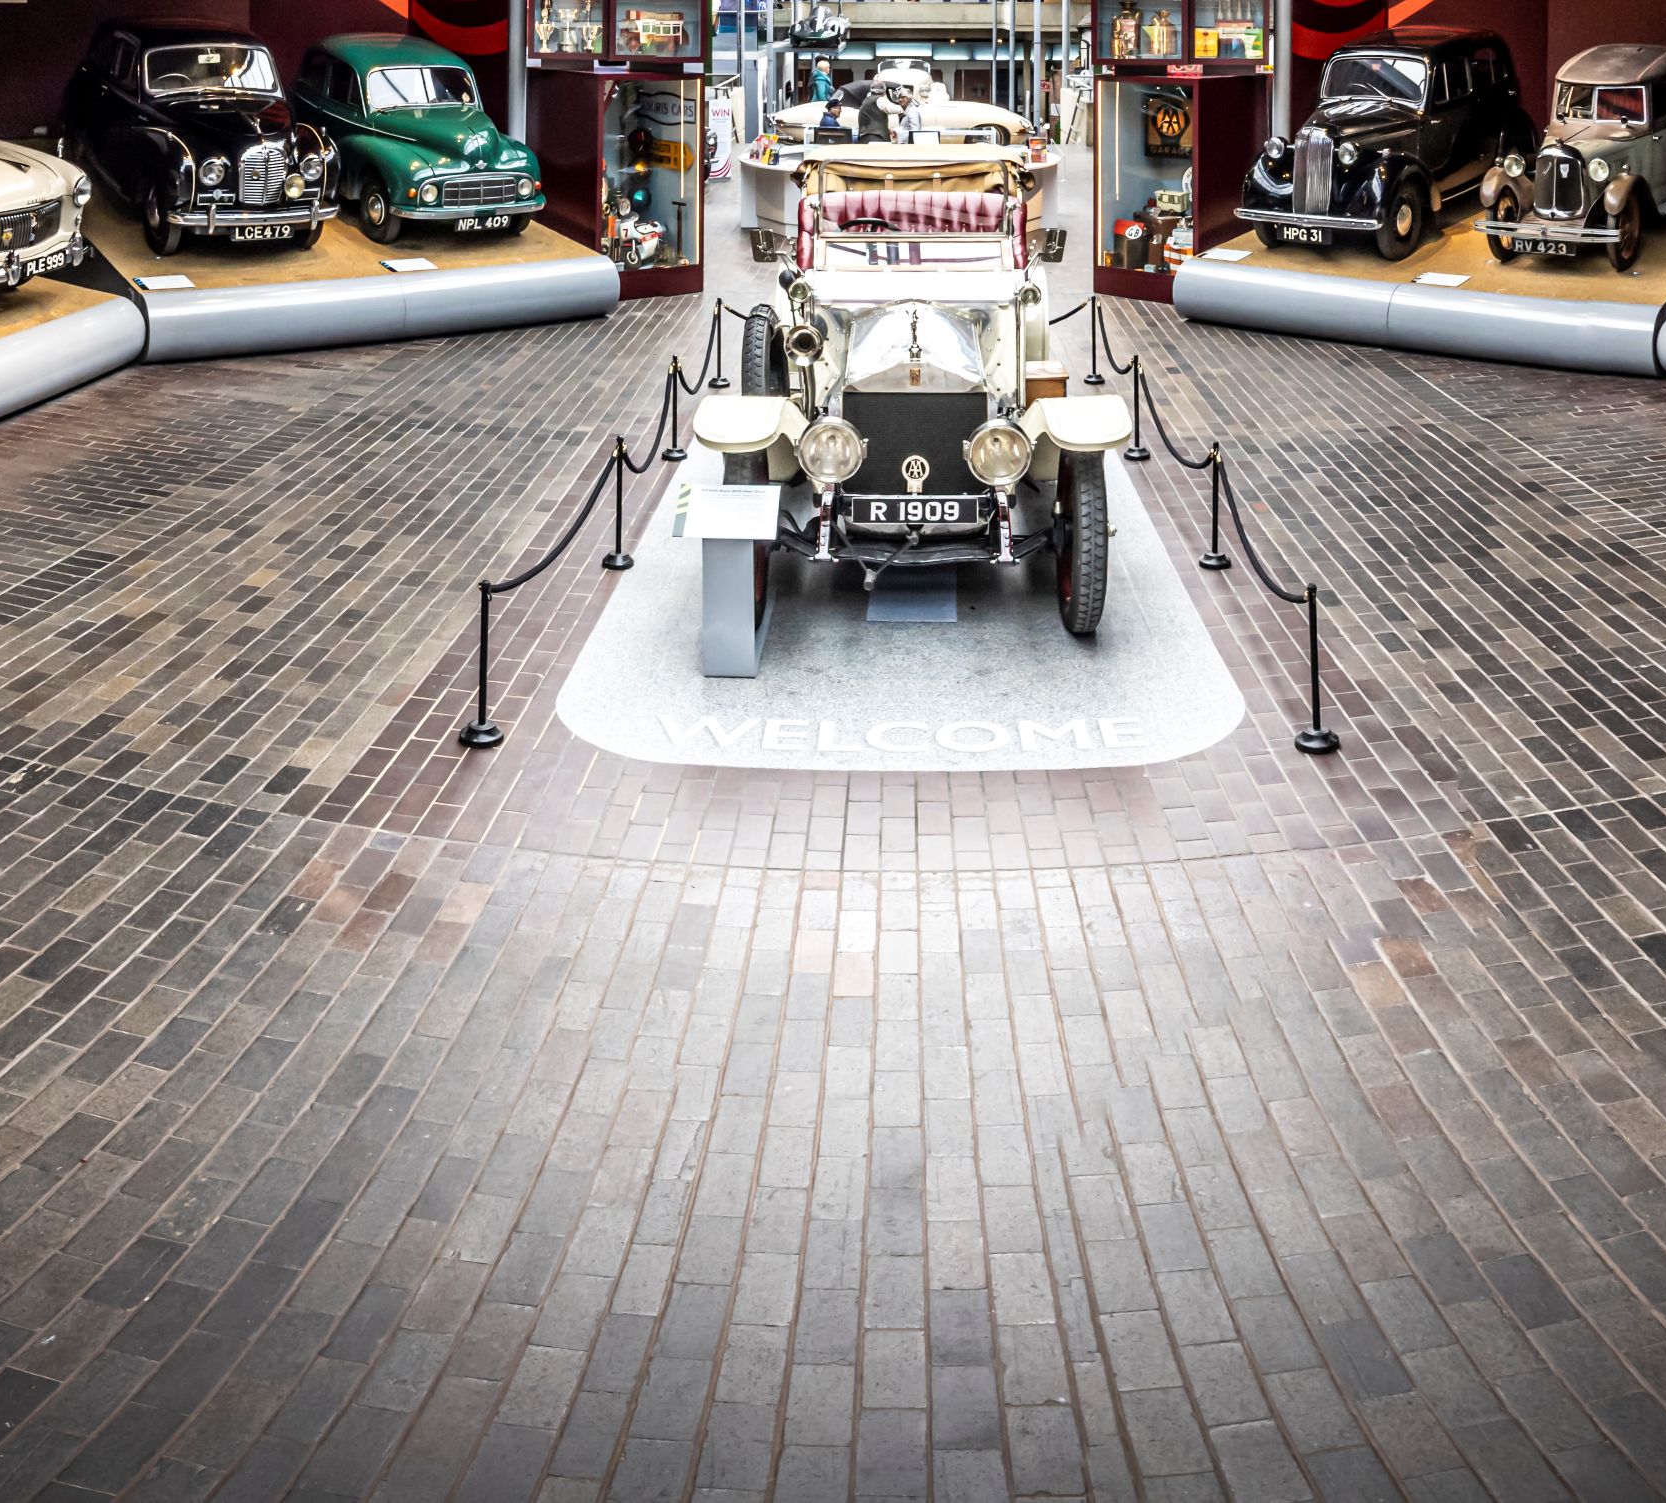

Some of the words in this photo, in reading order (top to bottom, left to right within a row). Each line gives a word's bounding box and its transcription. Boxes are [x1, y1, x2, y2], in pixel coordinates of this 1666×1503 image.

[711, 108, 730, 117] WIN
[457, 216, 482, 231] NPL
[484, 215, 510, 228] 409
[1128, 228, 1140, 238] GB
[1283, 227, 1308, 241] HPG
[1310, 229, 1323, 242] 31
[1515, 239, 1533, 252] RV
[1537, 242, 1568, 255] 423
[26, 256, 46, 278] PLE
[47, 251, 65, 271] 999
[869, 501, 888, 522] R
[898, 501, 960, 522] 1909
[656, 713, 1152, 753] WELCOME
